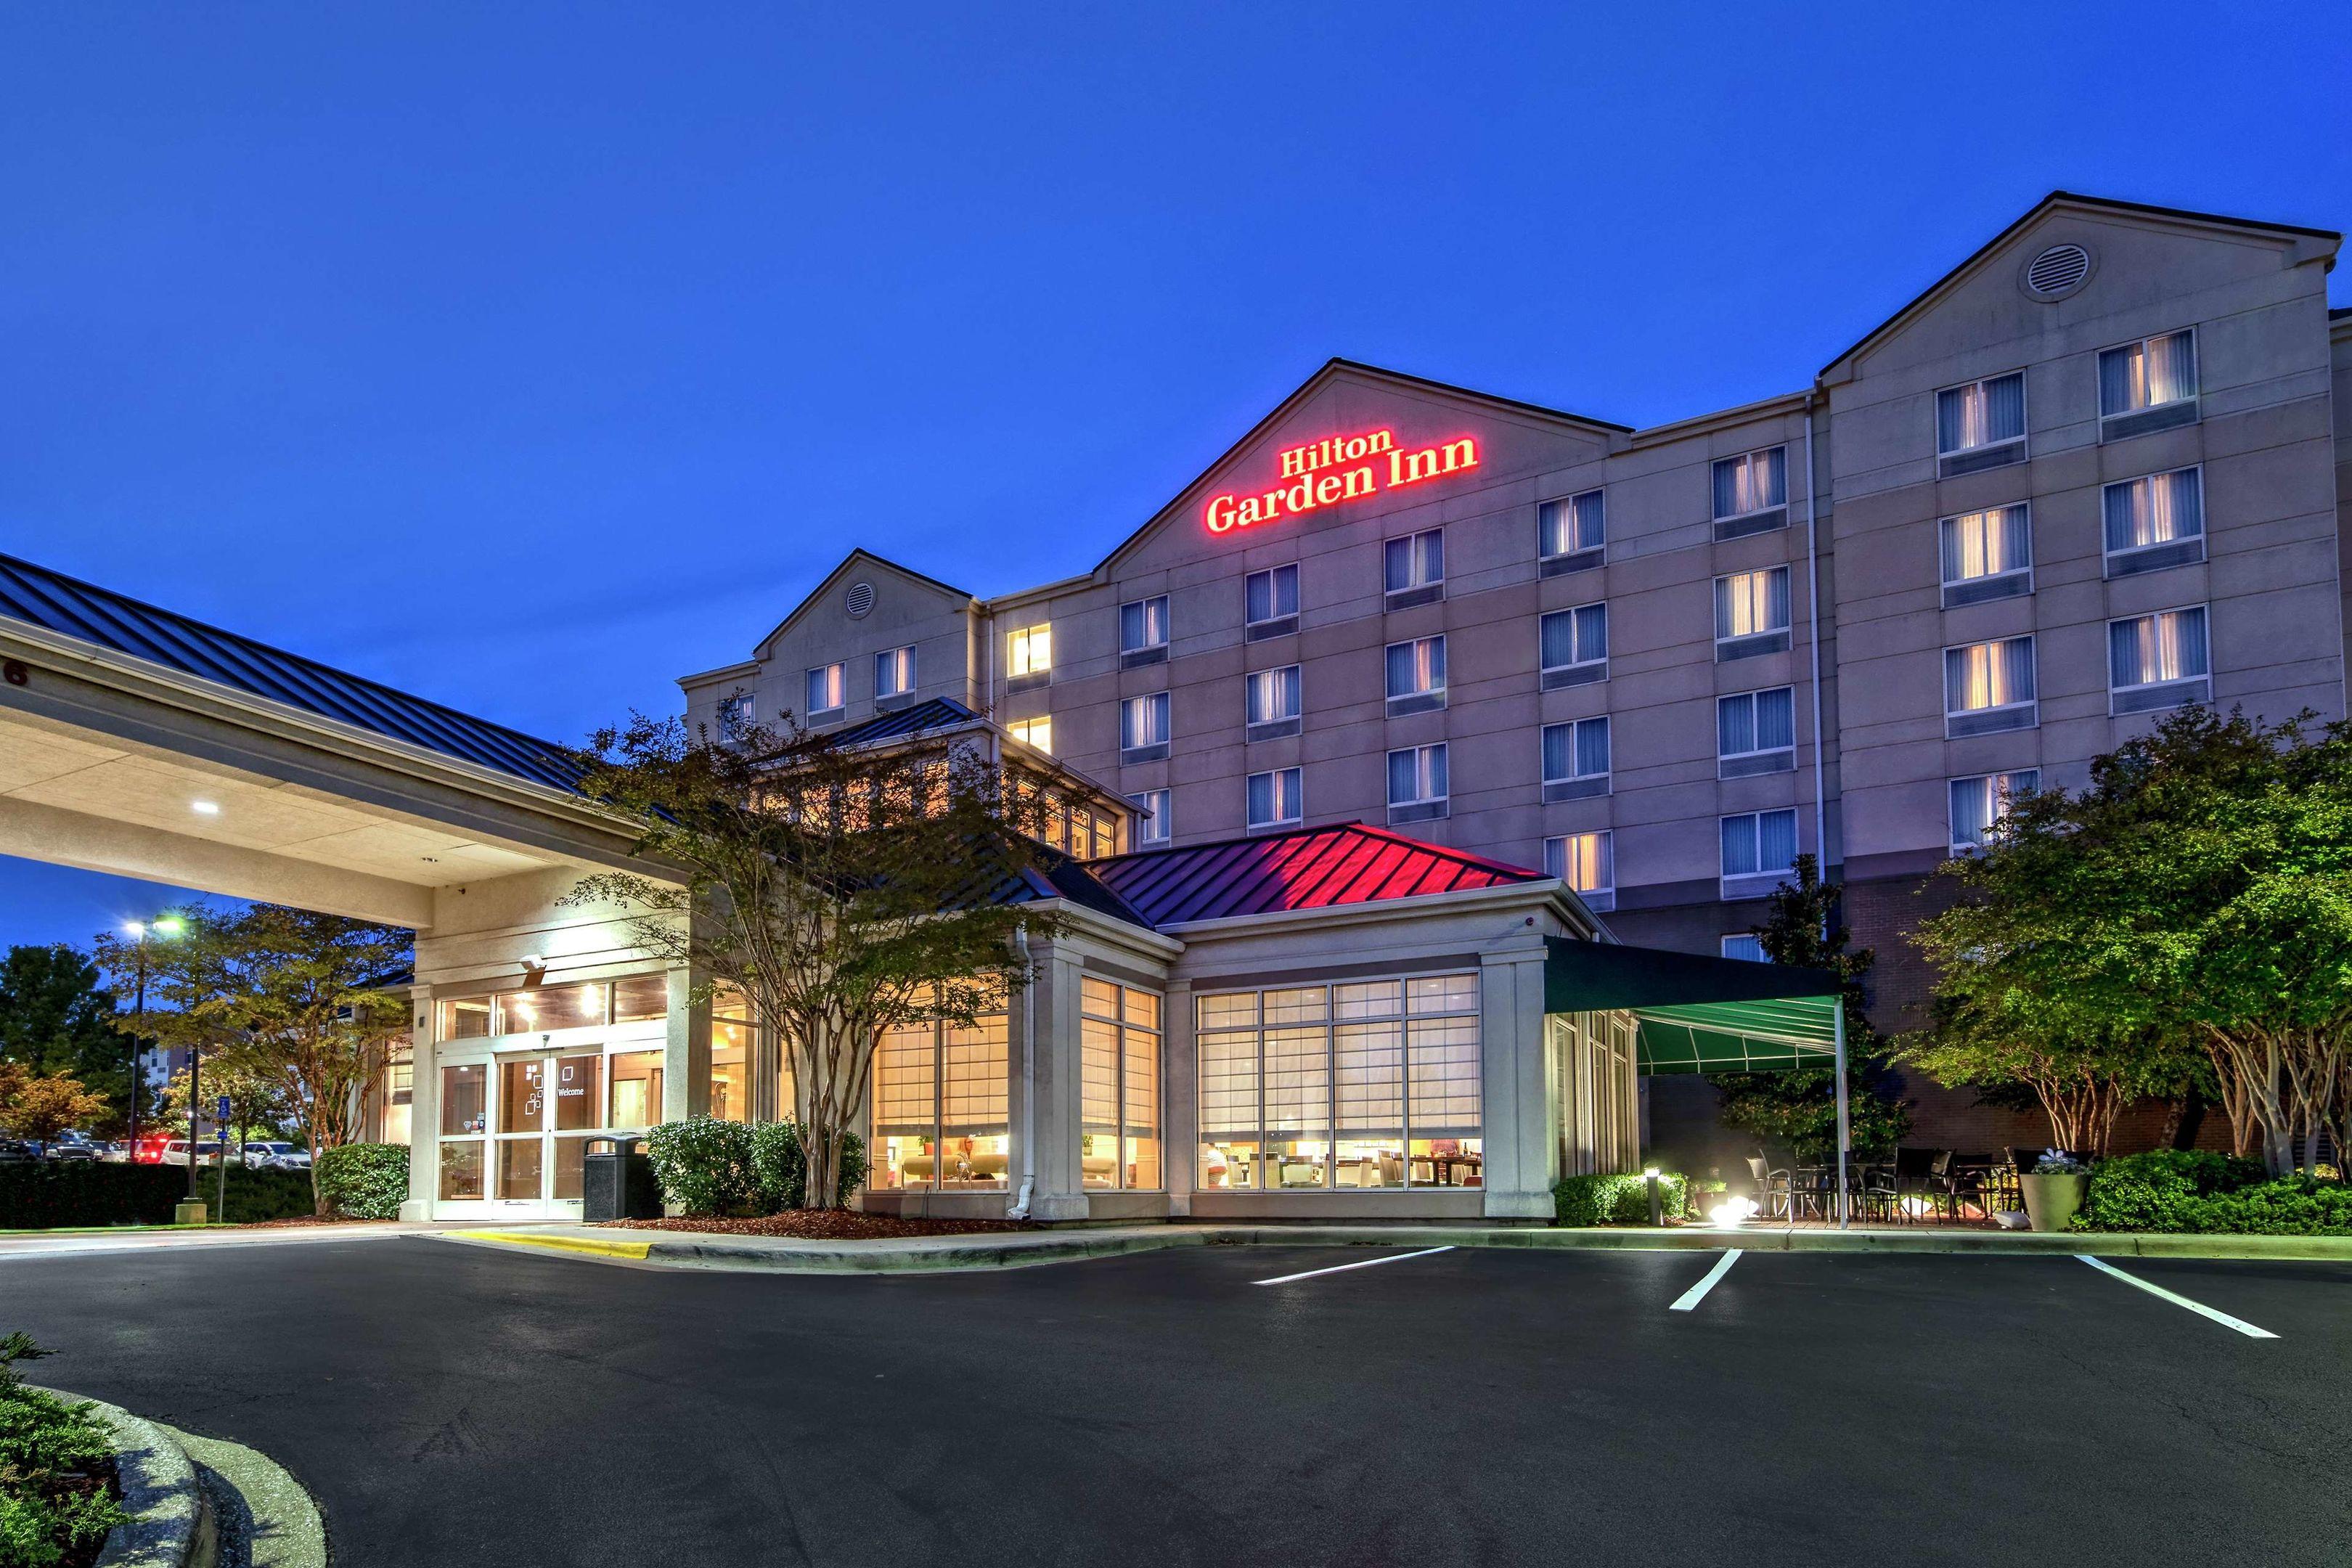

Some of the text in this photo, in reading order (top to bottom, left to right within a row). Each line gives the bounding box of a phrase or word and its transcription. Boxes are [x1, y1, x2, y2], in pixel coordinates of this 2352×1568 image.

[1281, 430, 1393, 478] Hilton
[1206, 439, 1478, 532] Garden Inn
[4, 660, 28, 686] 6
[558, 1087, 584, 1096] Welcome
